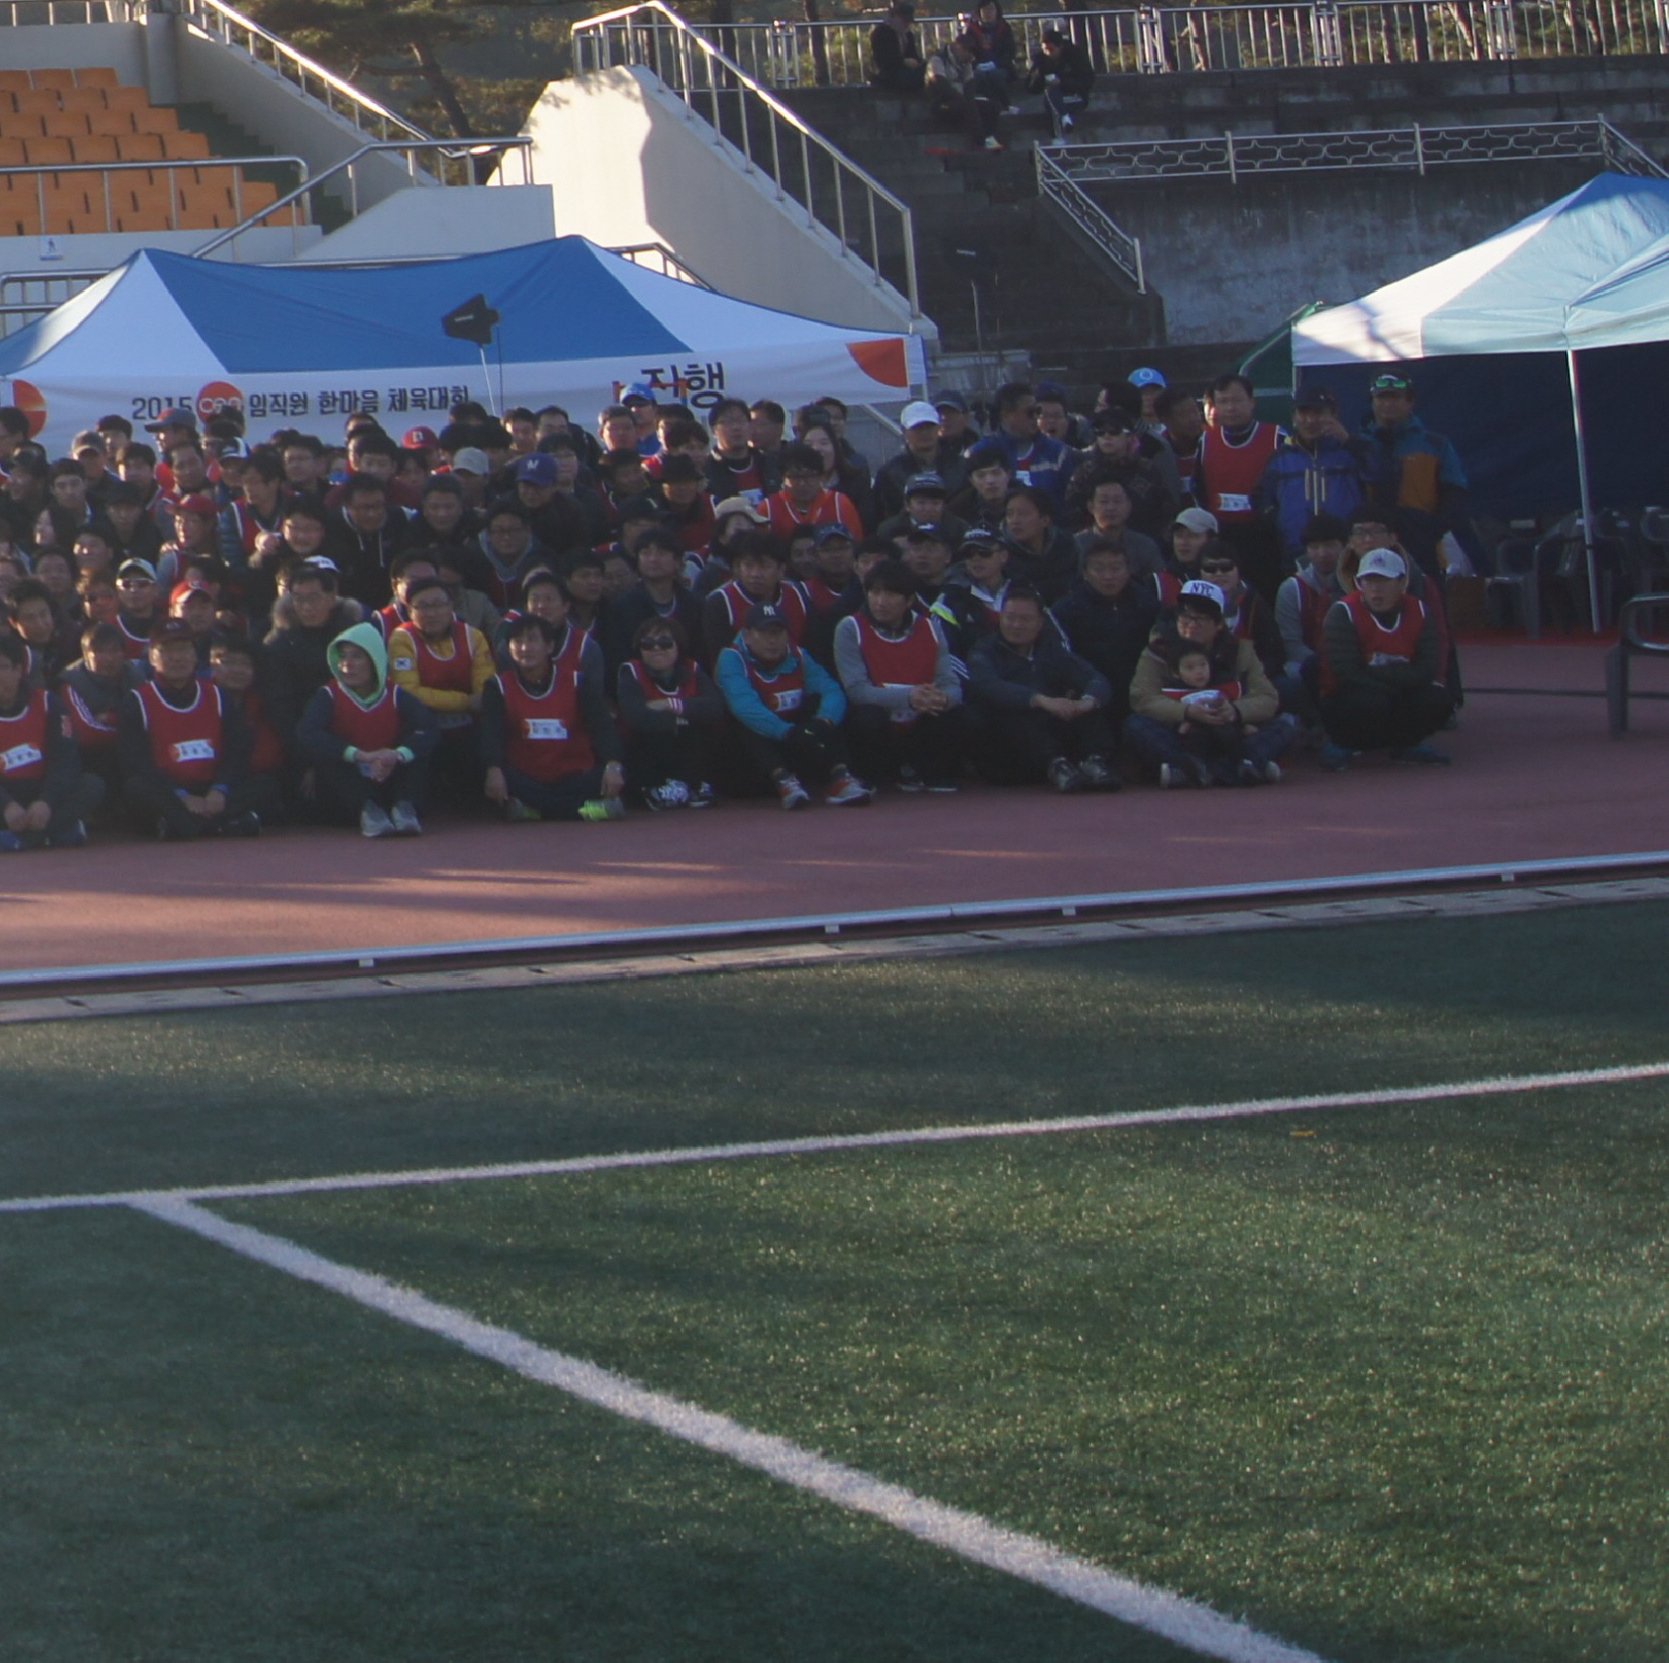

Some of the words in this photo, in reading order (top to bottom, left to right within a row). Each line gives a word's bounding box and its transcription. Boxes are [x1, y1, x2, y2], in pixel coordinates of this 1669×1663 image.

[248, 392, 309, 421] 임직원
[318, 388, 381, 418] 한마음
[388, 383, 469, 414] 체육대회
